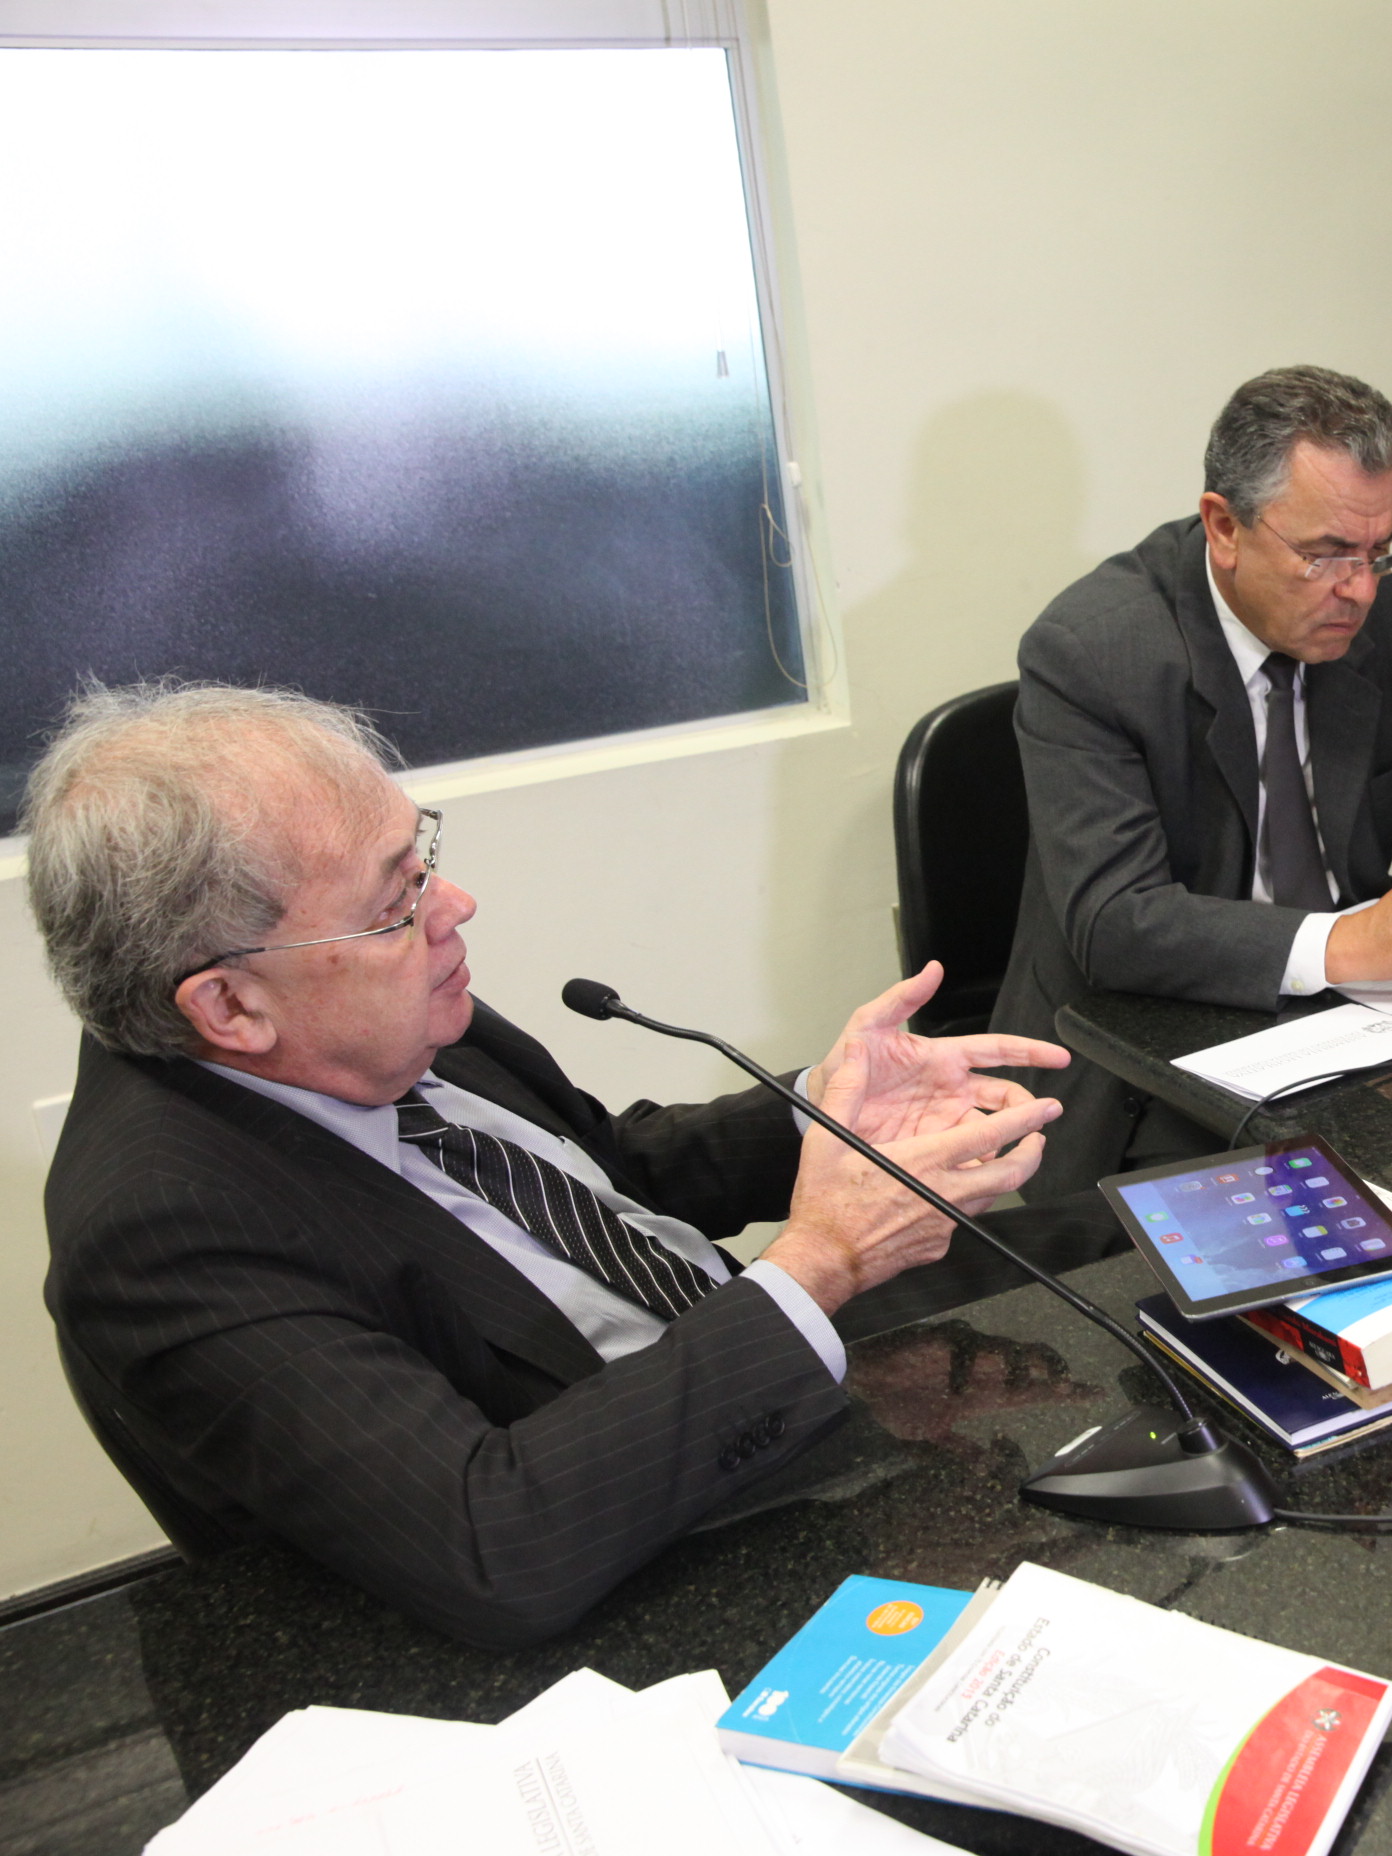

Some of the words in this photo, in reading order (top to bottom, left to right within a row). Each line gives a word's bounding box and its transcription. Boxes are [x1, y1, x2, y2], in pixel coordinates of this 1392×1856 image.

[1017, 1617, 1050, 1652] Estado
[996, 1647, 1050, 1711] Constituição
[1006, 1653, 1021, 1667] de
[982, 1668, 1013, 1697] Santa
[946, 1699, 988, 1743] Catarina
[985, 1712, 1000, 1727] do
[545, 1750, 578, 1808] CATARINA
[1291, 1734, 1328, 1791] ASSEMBLEIA
[513, 1760, 561, 1854] LEGISLATIVA
[566, 1806, 594, 1846] SANTA
[1260, 1791, 1300, 1850] LEGISLATIVA
